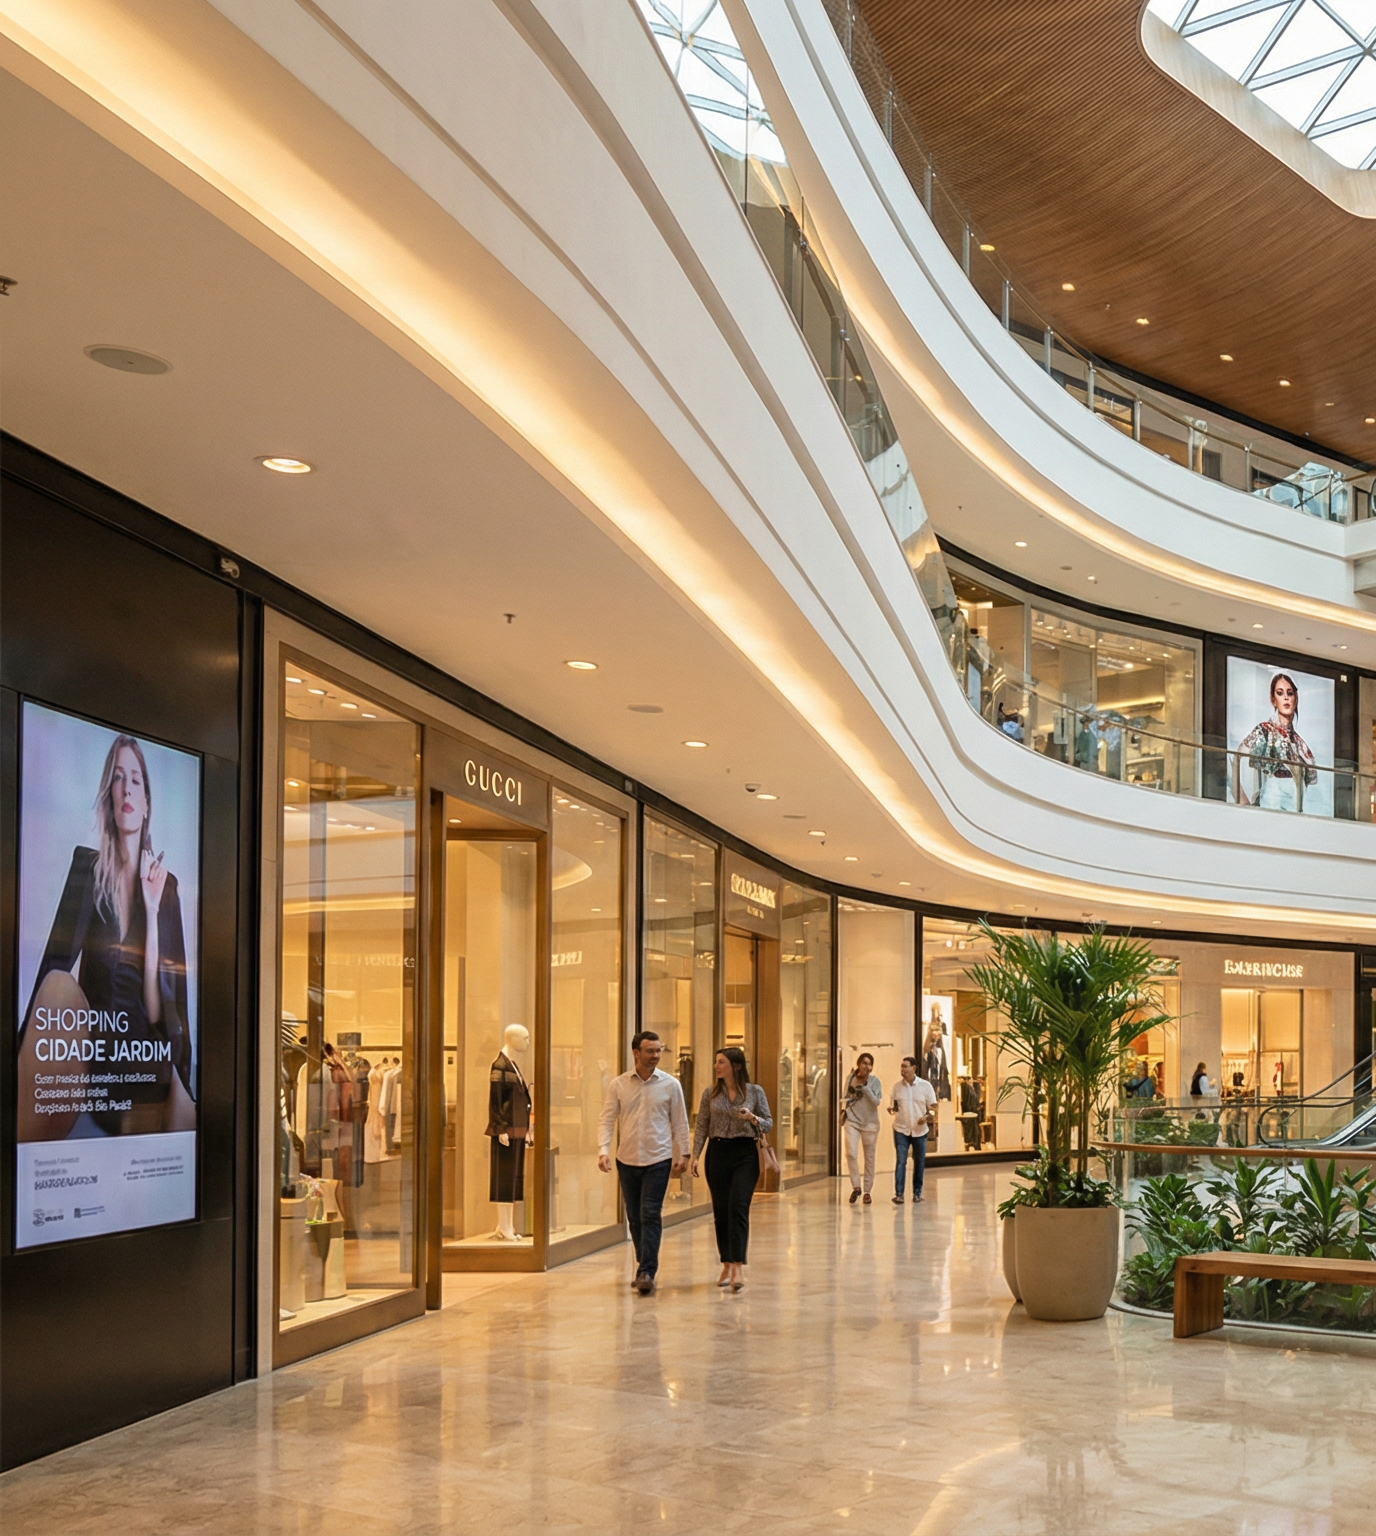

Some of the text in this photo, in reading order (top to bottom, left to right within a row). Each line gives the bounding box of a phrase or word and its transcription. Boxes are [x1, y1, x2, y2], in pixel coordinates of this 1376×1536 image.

[465, 759, 522, 806] GUCCI
[35, 1007, 129, 1033] SHOPPING
[35, 1038, 172, 1062] CIDADE JARDIM
